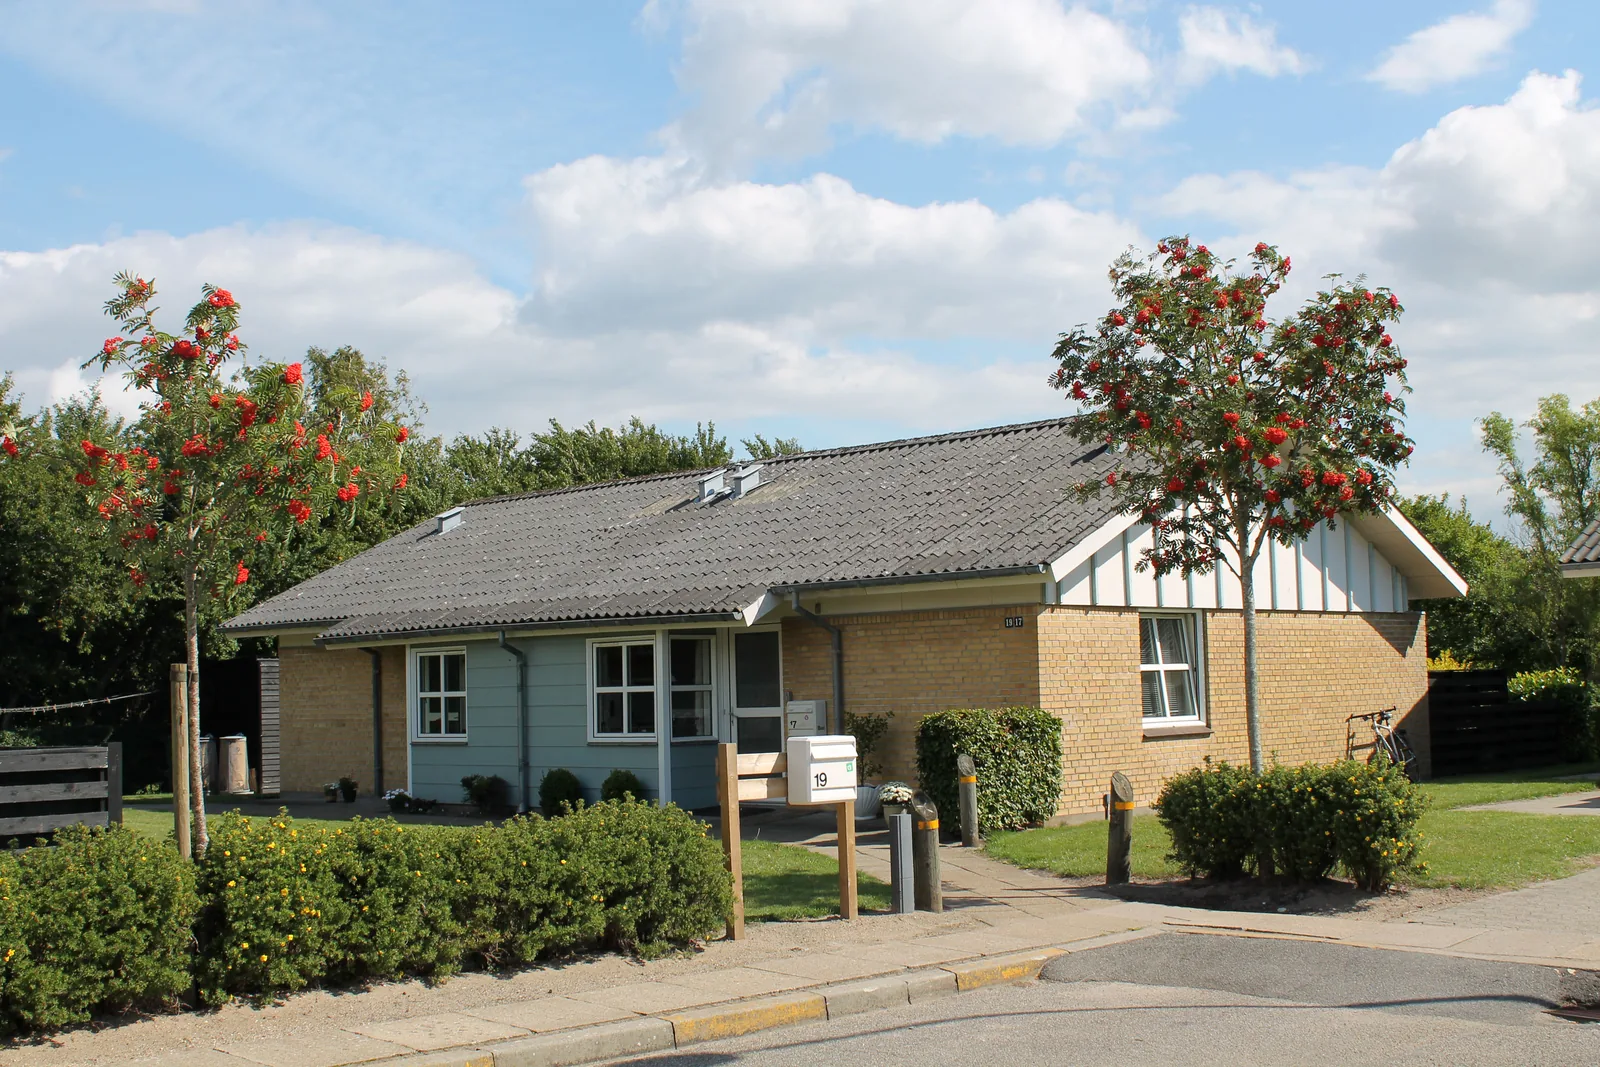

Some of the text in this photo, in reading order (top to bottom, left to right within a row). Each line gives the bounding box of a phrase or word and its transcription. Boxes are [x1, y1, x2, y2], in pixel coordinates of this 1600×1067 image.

[1005, 618, 1013, 627] 19
[1015, 617, 1022, 626] 17
[813, 772, 828, 788] 19
